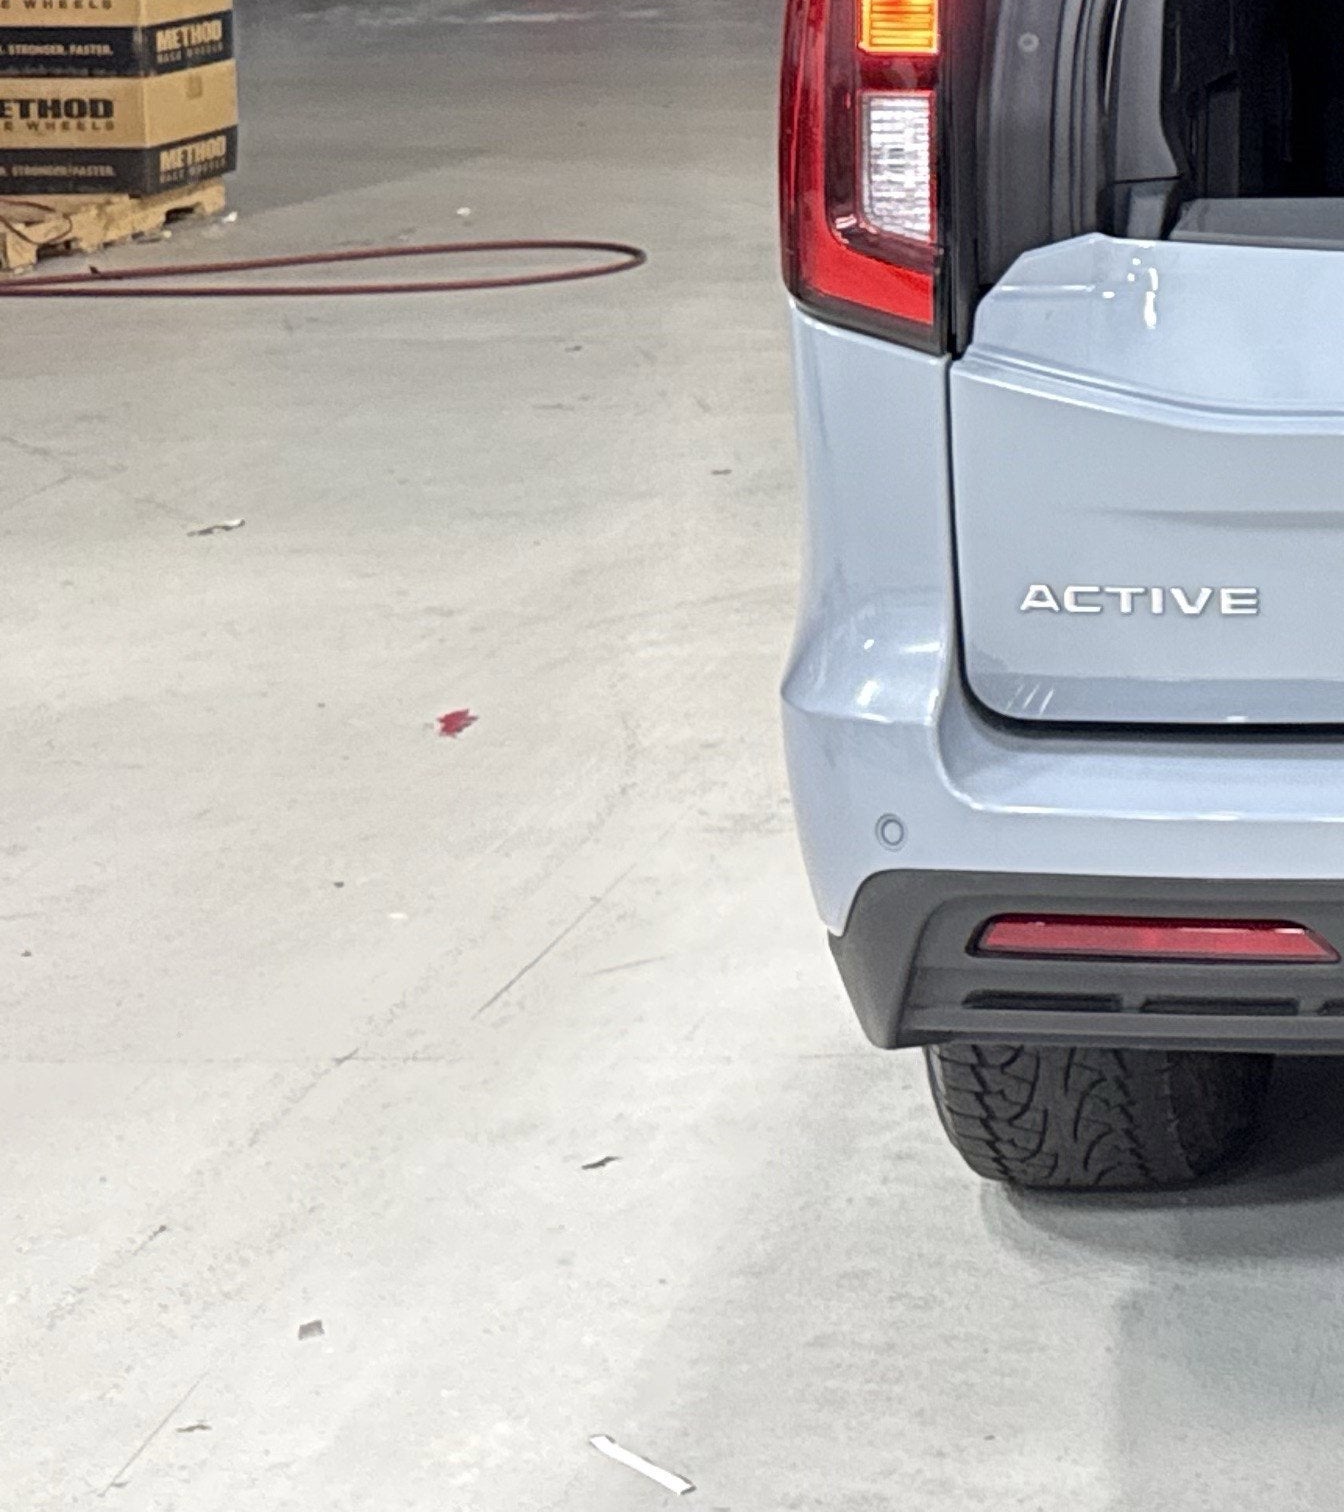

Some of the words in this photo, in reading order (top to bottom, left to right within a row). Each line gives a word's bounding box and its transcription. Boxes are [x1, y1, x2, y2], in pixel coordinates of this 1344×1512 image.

[156, 19, 224, 52] METHOD
[159, 135, 227, 172] METHOD
[1020, 584, 1259, 615] ACTIVE
